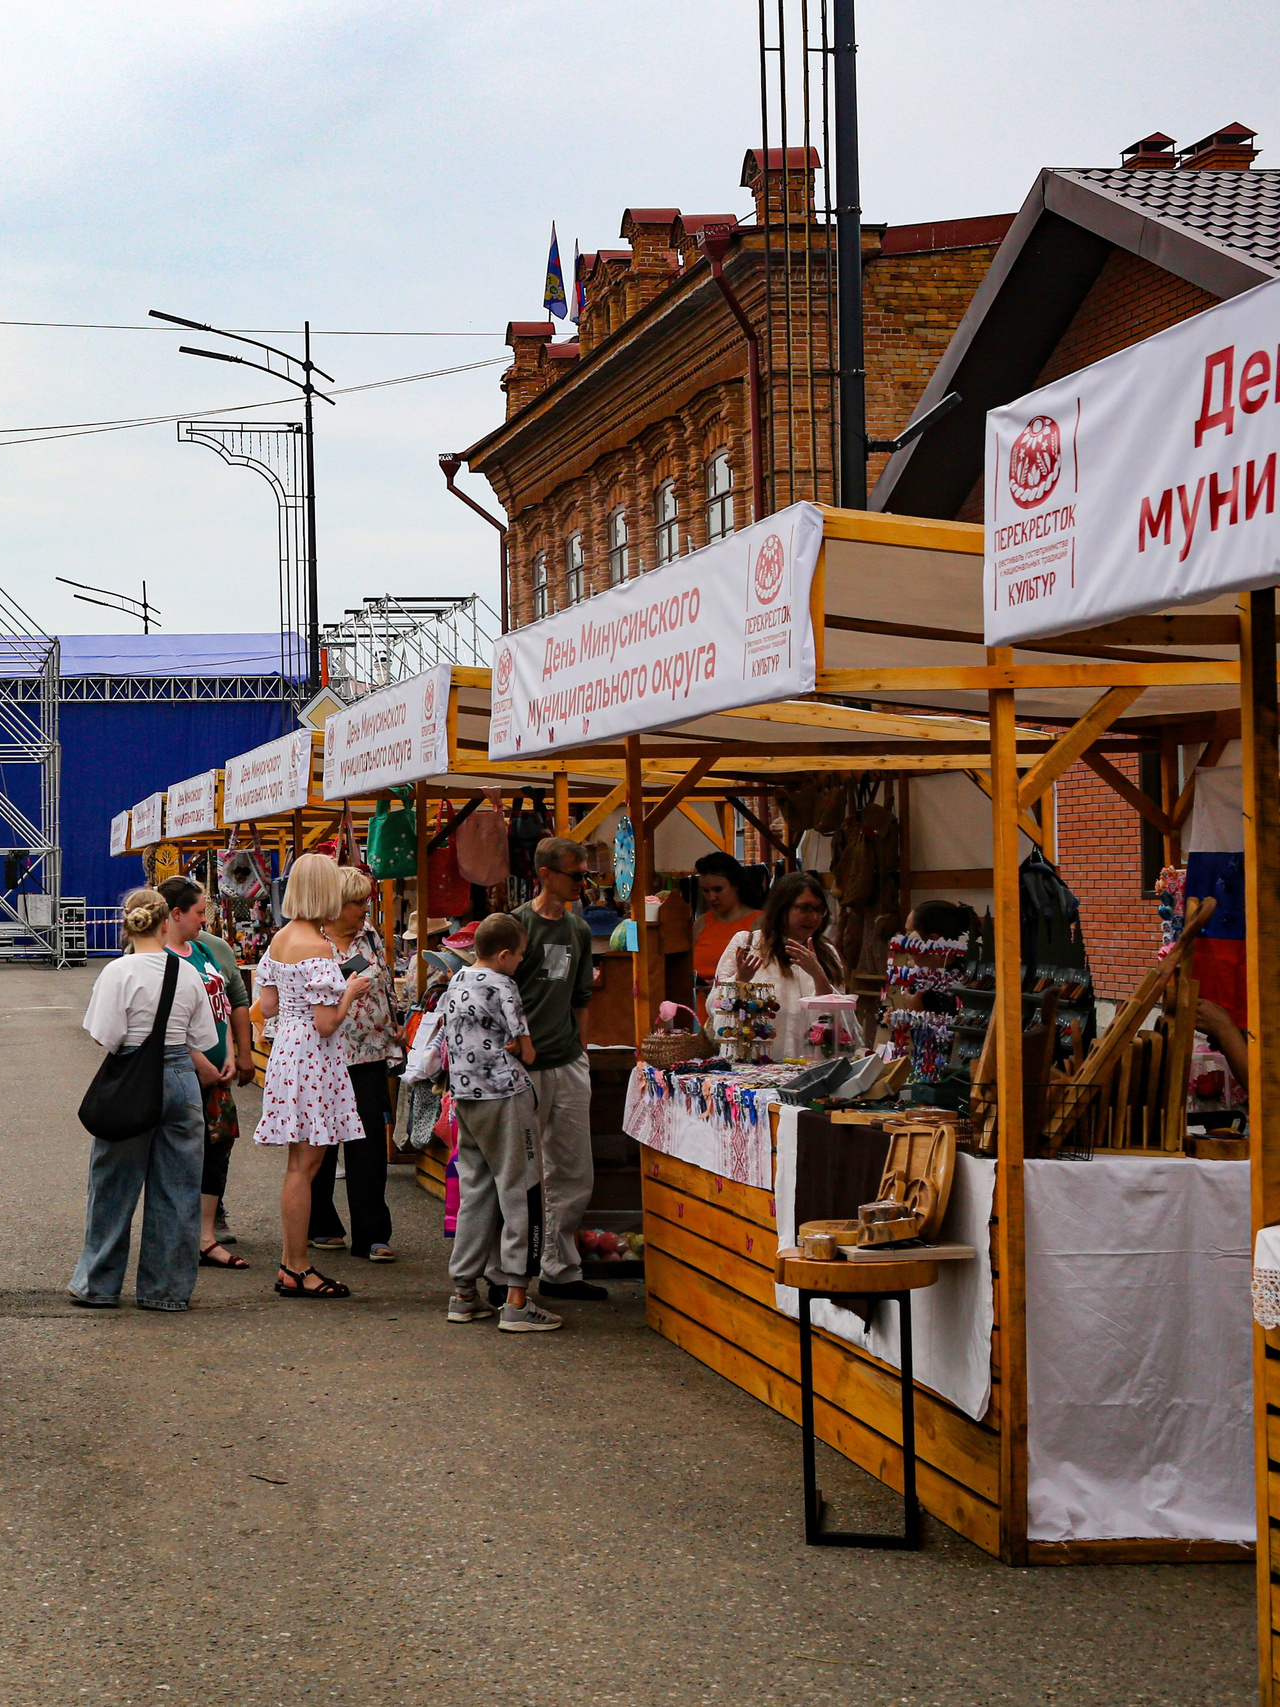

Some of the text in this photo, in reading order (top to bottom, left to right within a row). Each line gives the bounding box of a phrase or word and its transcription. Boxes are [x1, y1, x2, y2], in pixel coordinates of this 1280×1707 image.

[994, 503, 1077, 553] ПЕРЕКРЕСТОК
[1008, 571, 1056, 607] КУЛЬТУР
[542, 587, 701, 682] День Минусинского
[745, 604, 792, 636] ПЕРЕКРЕСТОК
[527, 642, 717, 736] муниципального округа
[347, 720, 360, 749] День
[361, 702, 407, 741] Минусинского
[388, 738, 412, 772] округа
